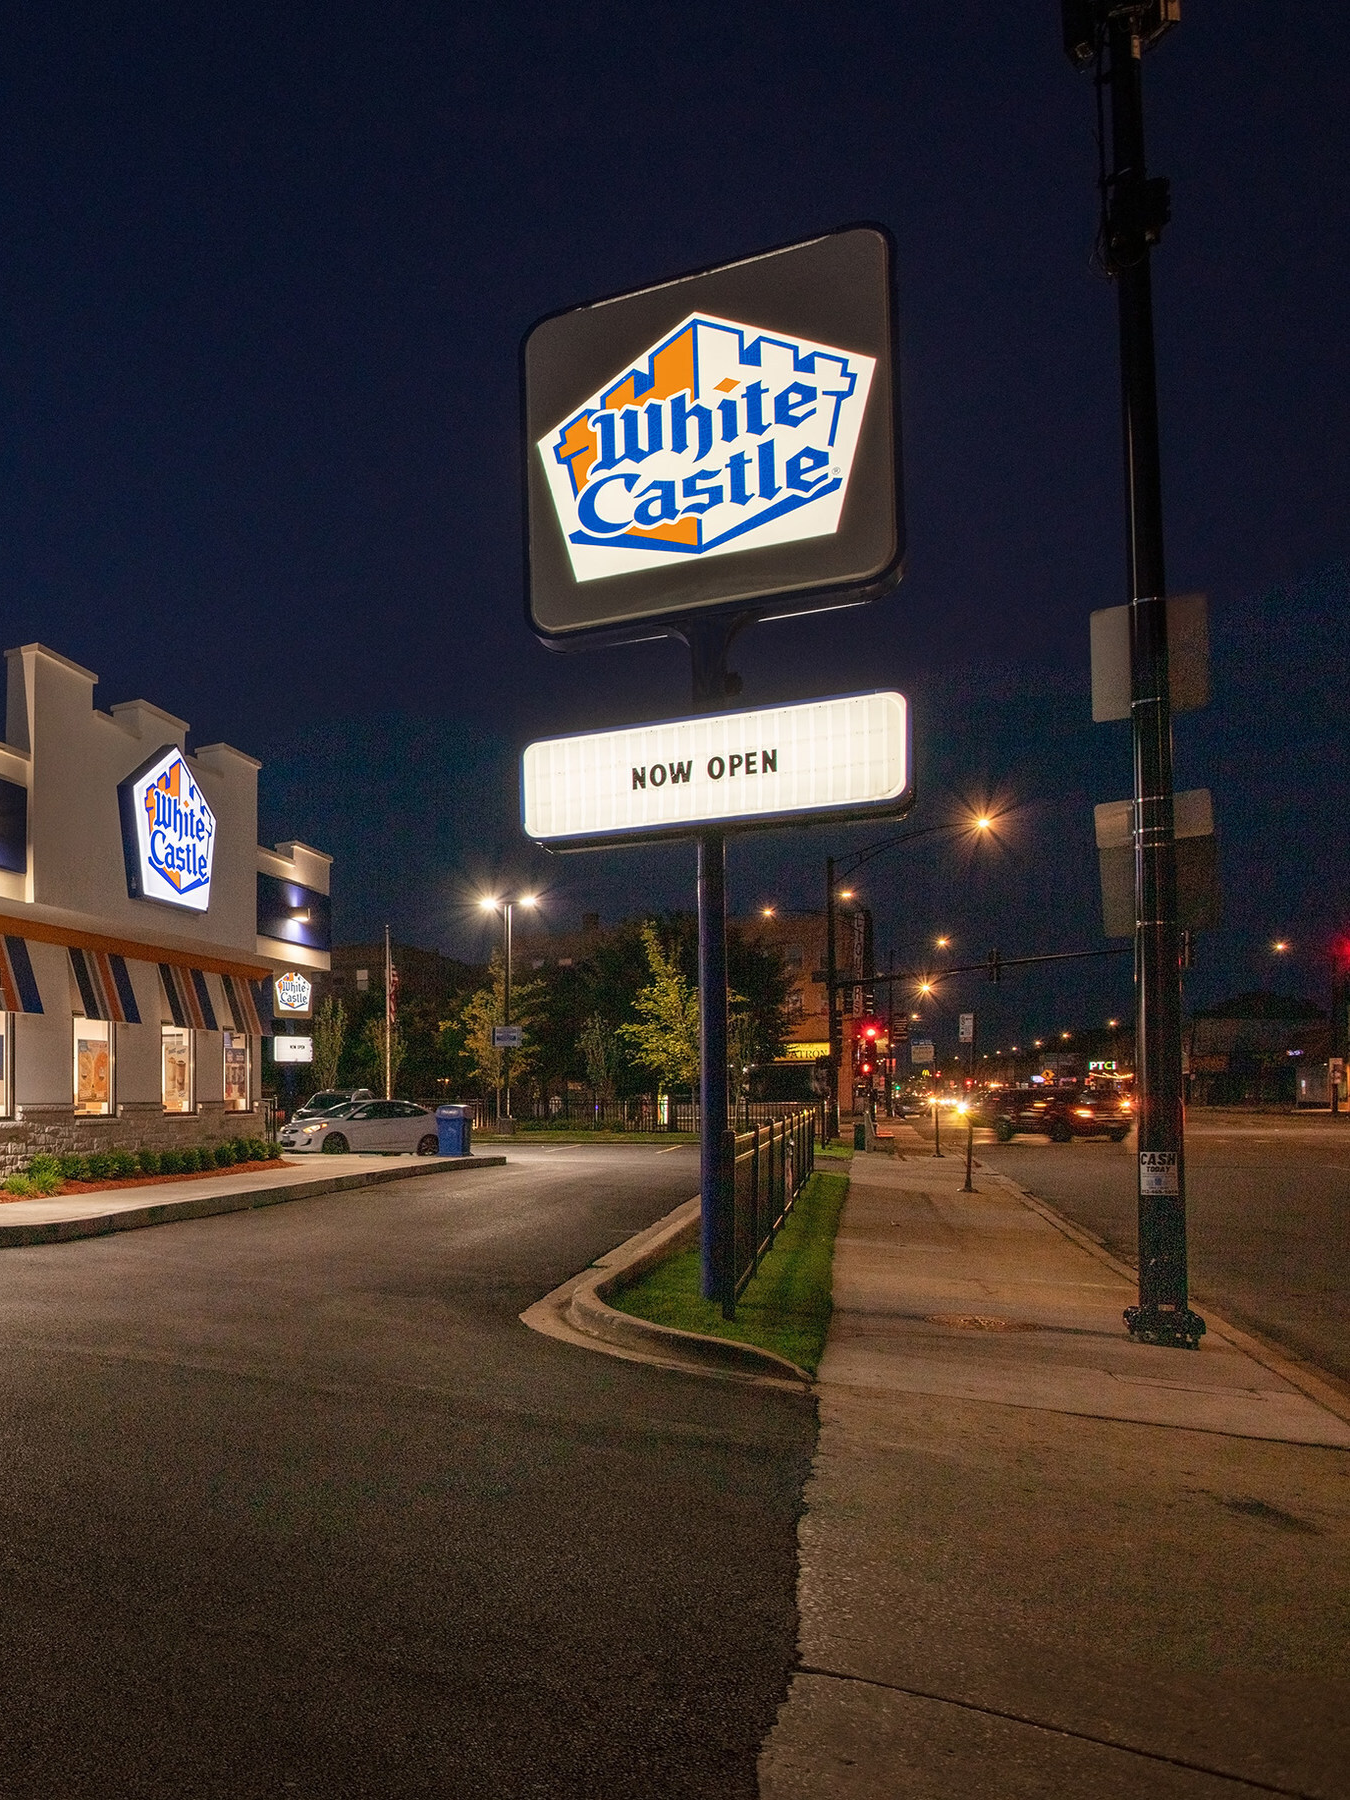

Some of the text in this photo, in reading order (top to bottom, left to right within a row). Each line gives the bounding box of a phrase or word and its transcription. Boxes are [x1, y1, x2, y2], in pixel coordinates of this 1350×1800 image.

[590, 377, 818, 477] White
[577, 438, 830, 534] Castle
[631, 748, 778, 790] NOW OPEN
[153, 790, 205, 842] White
[150, 829, 208, 879] Castle
[280, 992, 308, 1003] Castle
[282, 981, 306, 993] White
[786, 1047, 828, 1060] ATRÓN
[1140, 1152, 1176, 1166] CASH
